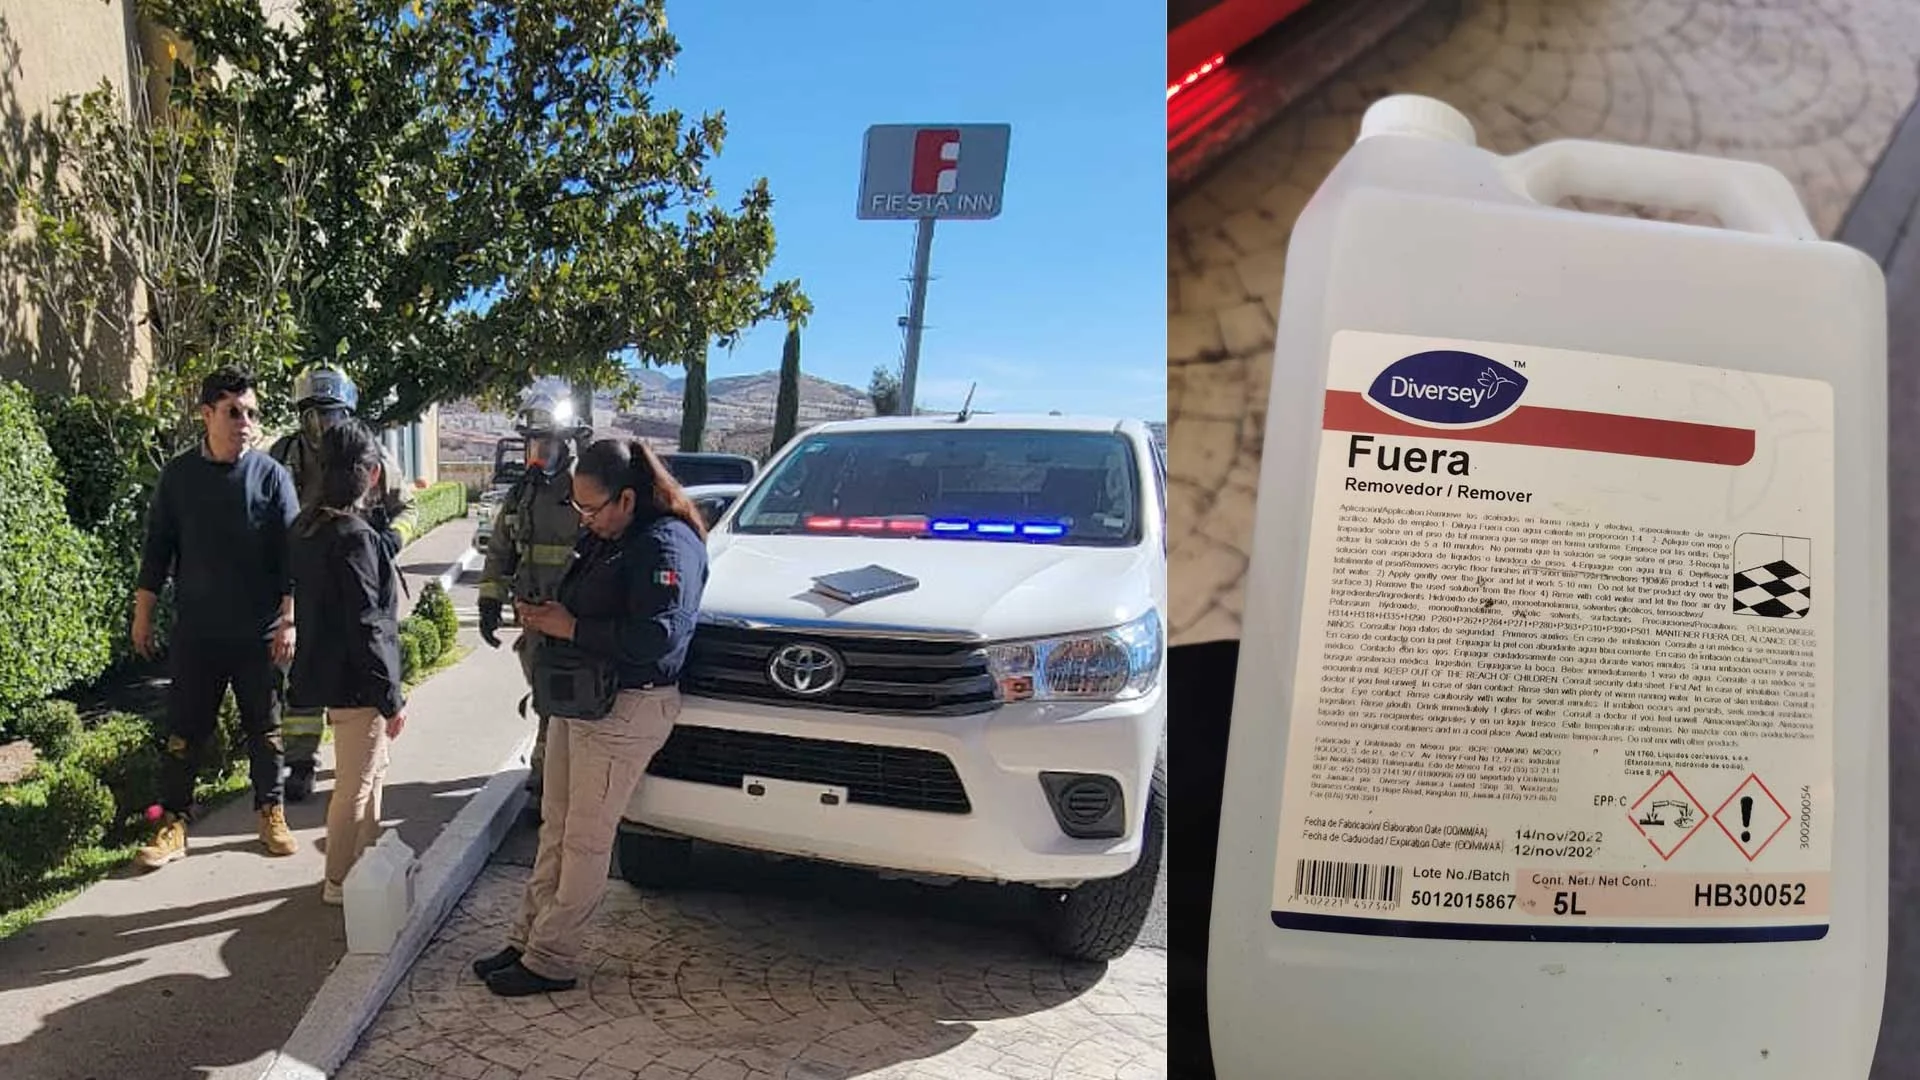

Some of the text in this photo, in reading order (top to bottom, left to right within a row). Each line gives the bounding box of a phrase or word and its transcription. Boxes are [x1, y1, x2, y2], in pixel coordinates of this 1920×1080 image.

[872, 194, 994, 212] FIESTA INN
[1390, 376, 1485, 408] Diversey
[1348, 434, 1470, 476] Fuera
[1345, 478, 1532, 503] Removedor / Remover
[1465, 670, 1496, 679] REACH
[1594, 795, 1616, 806] EPP:
[1304, 816, 1326, 827] Fecha
[1328, 818, 1337, 828] de
[1382, 821, 1423, 833] Elaboration
[1425, 824, 1441, 834] Date
[1800, 785, 1810, 850] 300200054
[1302, 830, 1328, 840] Fecha
[1329, 832, 1340, 842] de
[1341, 833, 1384, 845] Caducidad
[1390, 836, 1430, 848] Expiration
[1514, 845, 1601, 858] 12/nov/202
[1413, 866, 1510, 883] Lote No./Batch
[1532, 874, 1564, 886] Cont.
[1598, 875, 1618, 886] Net
[1410, 891, 1516, 910] 5012015867
[1553, 891, 1586, 915] 5L
[1695, 883, 1806, 906] HB30052
